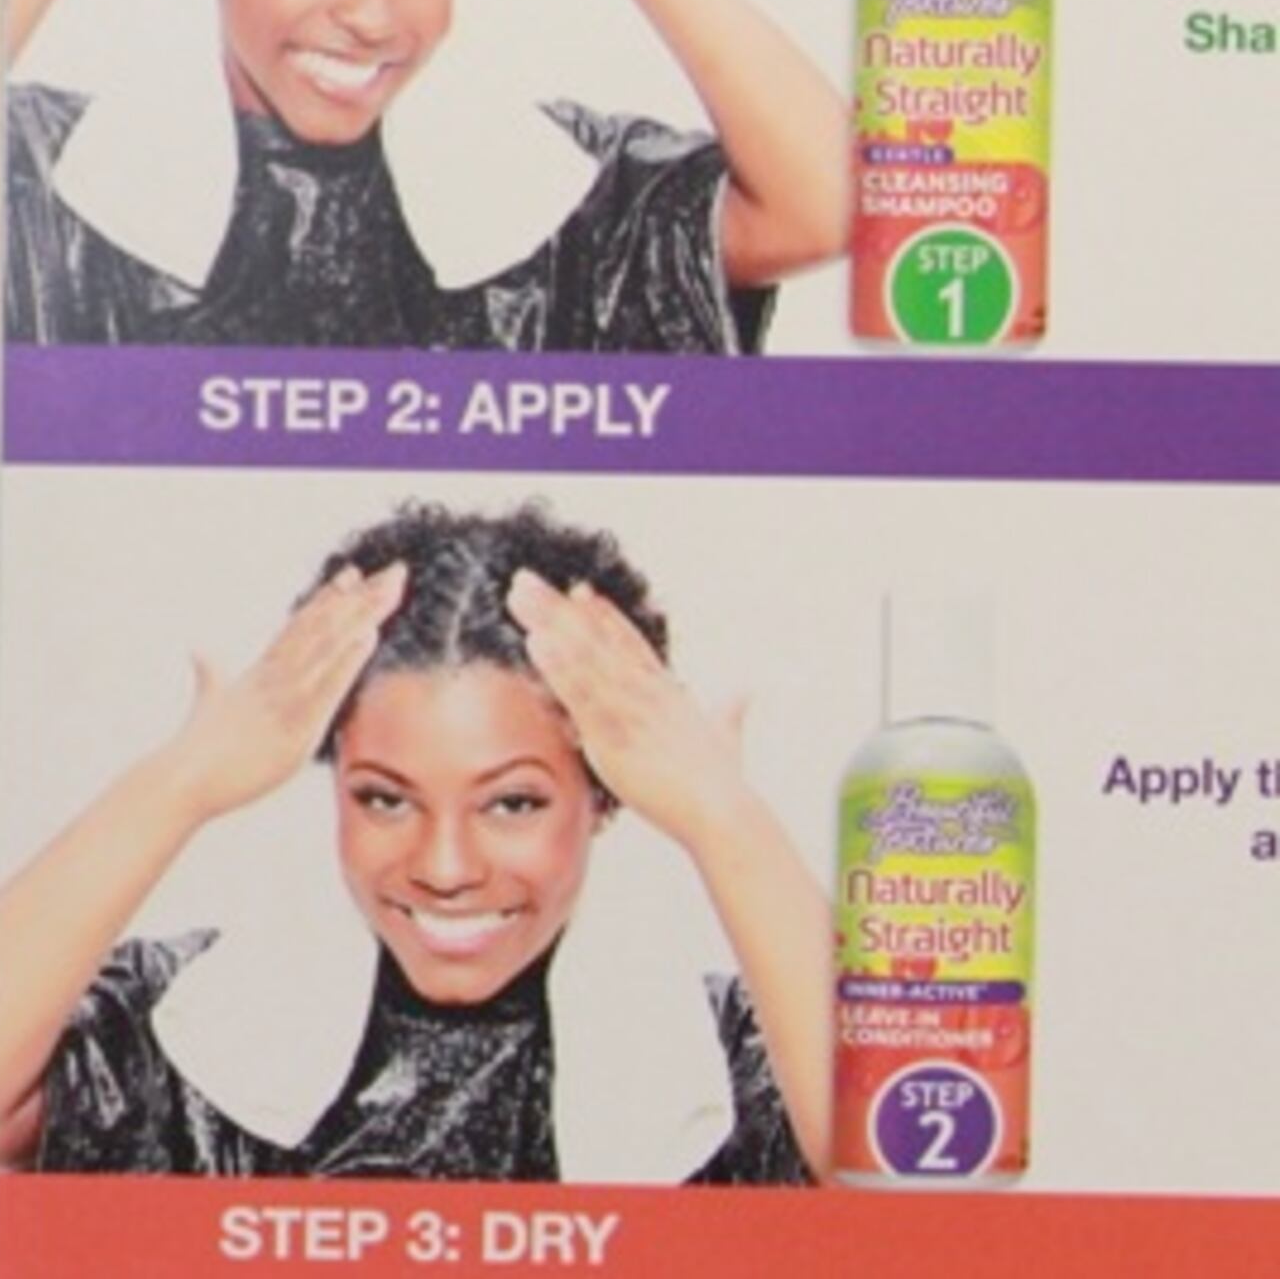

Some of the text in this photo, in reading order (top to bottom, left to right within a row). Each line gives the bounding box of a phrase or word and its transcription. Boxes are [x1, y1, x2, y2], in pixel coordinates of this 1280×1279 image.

[1183, 10, 1277, 54] Sha
[875, 77, 1028, 125] Straight
[862, 171, 1010, 195] CLEANSING
[862, 196, 998, 218] SHAMPOO
[918, 244, 989, 273] STEP
[938, 277, 965, 338] 1
[198, 377, 671, 438] STEP 2: APPLY
[1102, 755, 1242, 806] Apply
[859, 916, 1012, 962] Straight
[842, 1028, 994, 1050] CONDITIONER
[900, 1081, 974, 1110] STEP
[916, 1110, 960, 1170] 2
[217, 1206, 620, 1266] STEP 3: DRY
